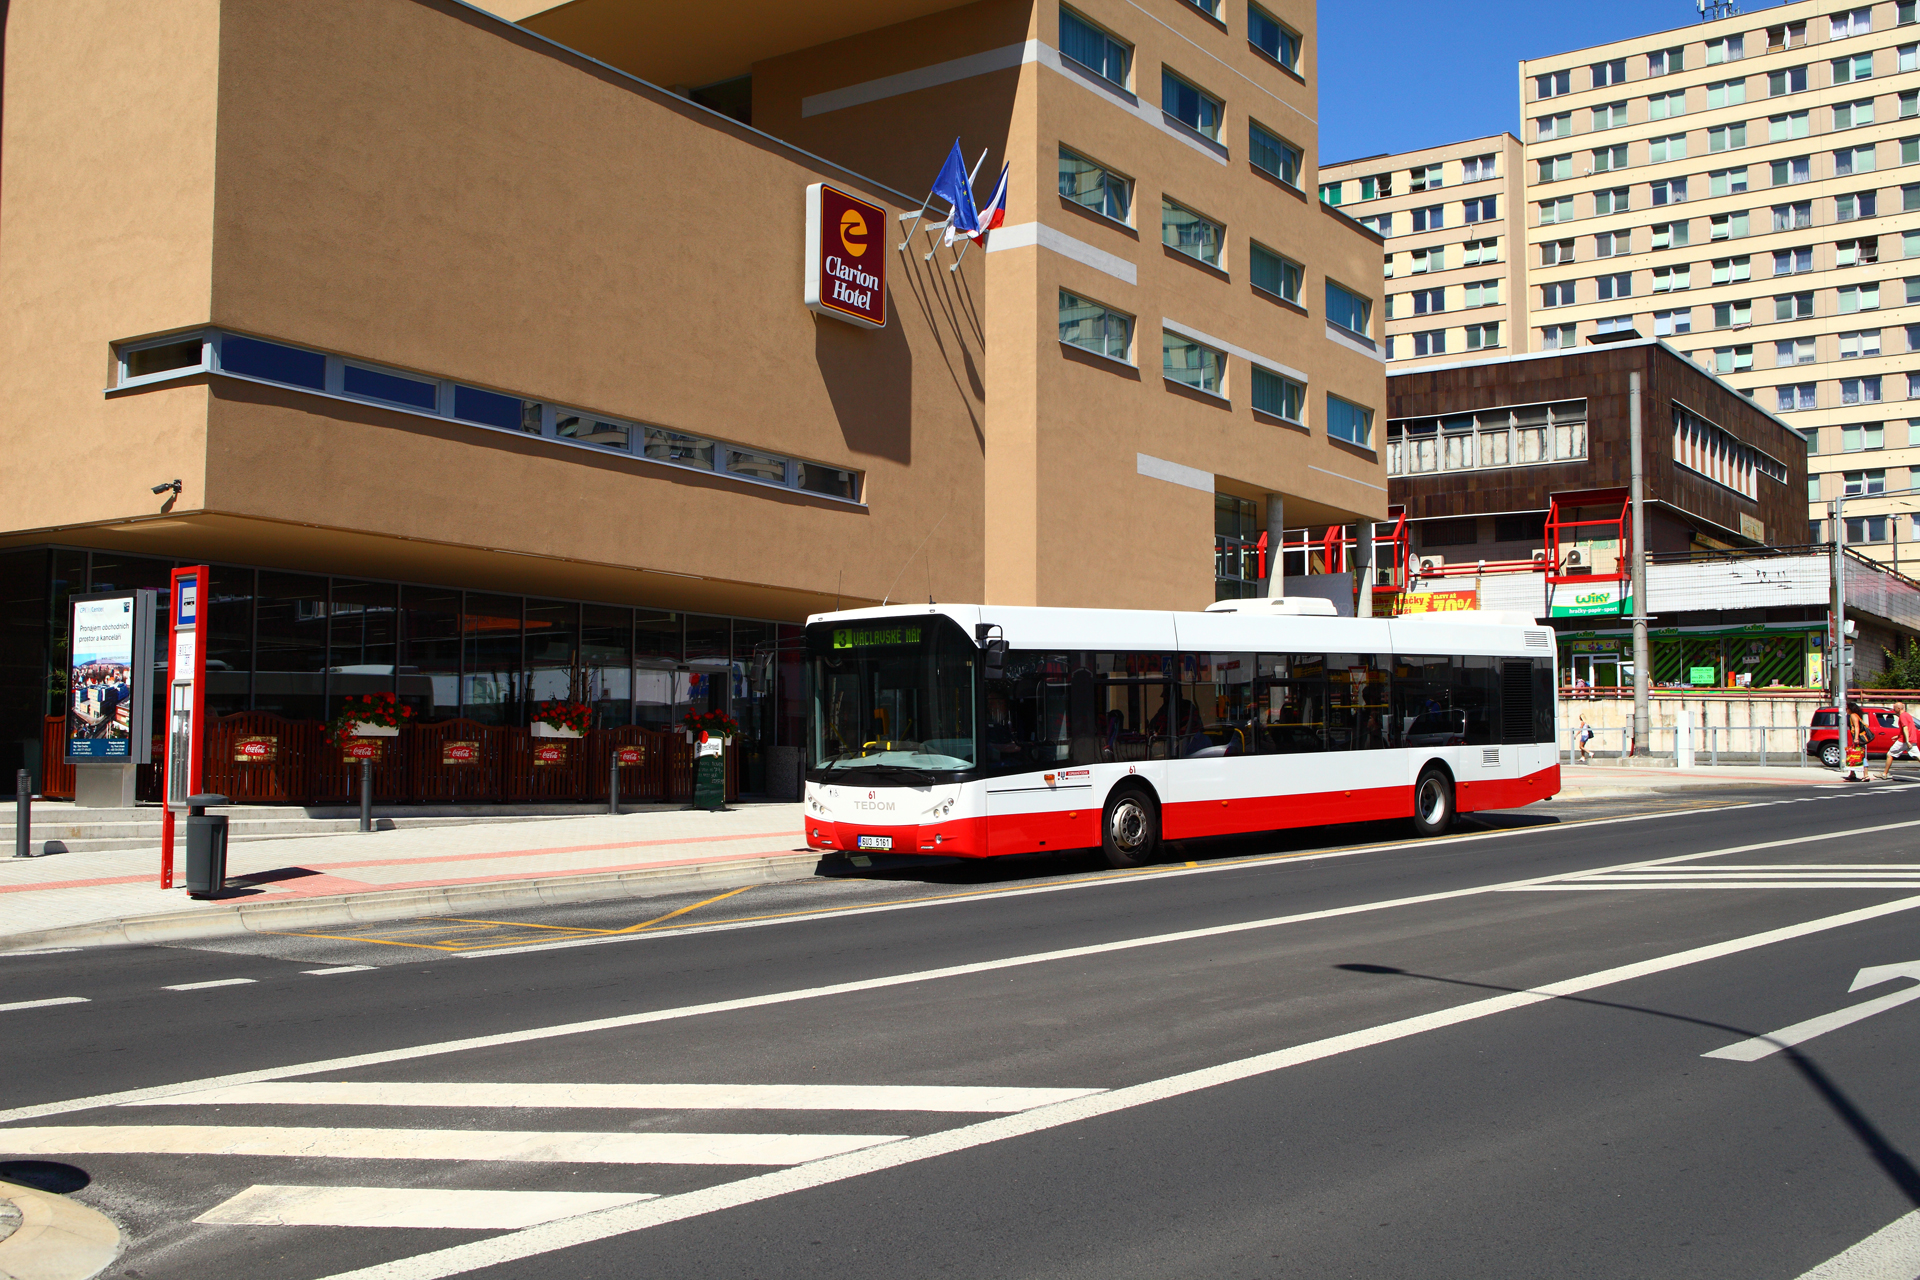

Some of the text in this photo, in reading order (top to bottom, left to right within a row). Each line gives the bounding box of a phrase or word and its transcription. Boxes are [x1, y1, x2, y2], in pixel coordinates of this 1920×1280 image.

[825, 256, 879, 292] Clarion
[832, 280, 871, 311] Hotel
[838, 630, 846, 647] 3
[853, 626, 901, 646] VÁCLAVSKÉ
[1129, 765, 1136, 774] 61
[868, 790, 876, 799] 61
[854, 801, 896, 810] TEDOM
[862, 838, 889, 846] 6U3 5161
